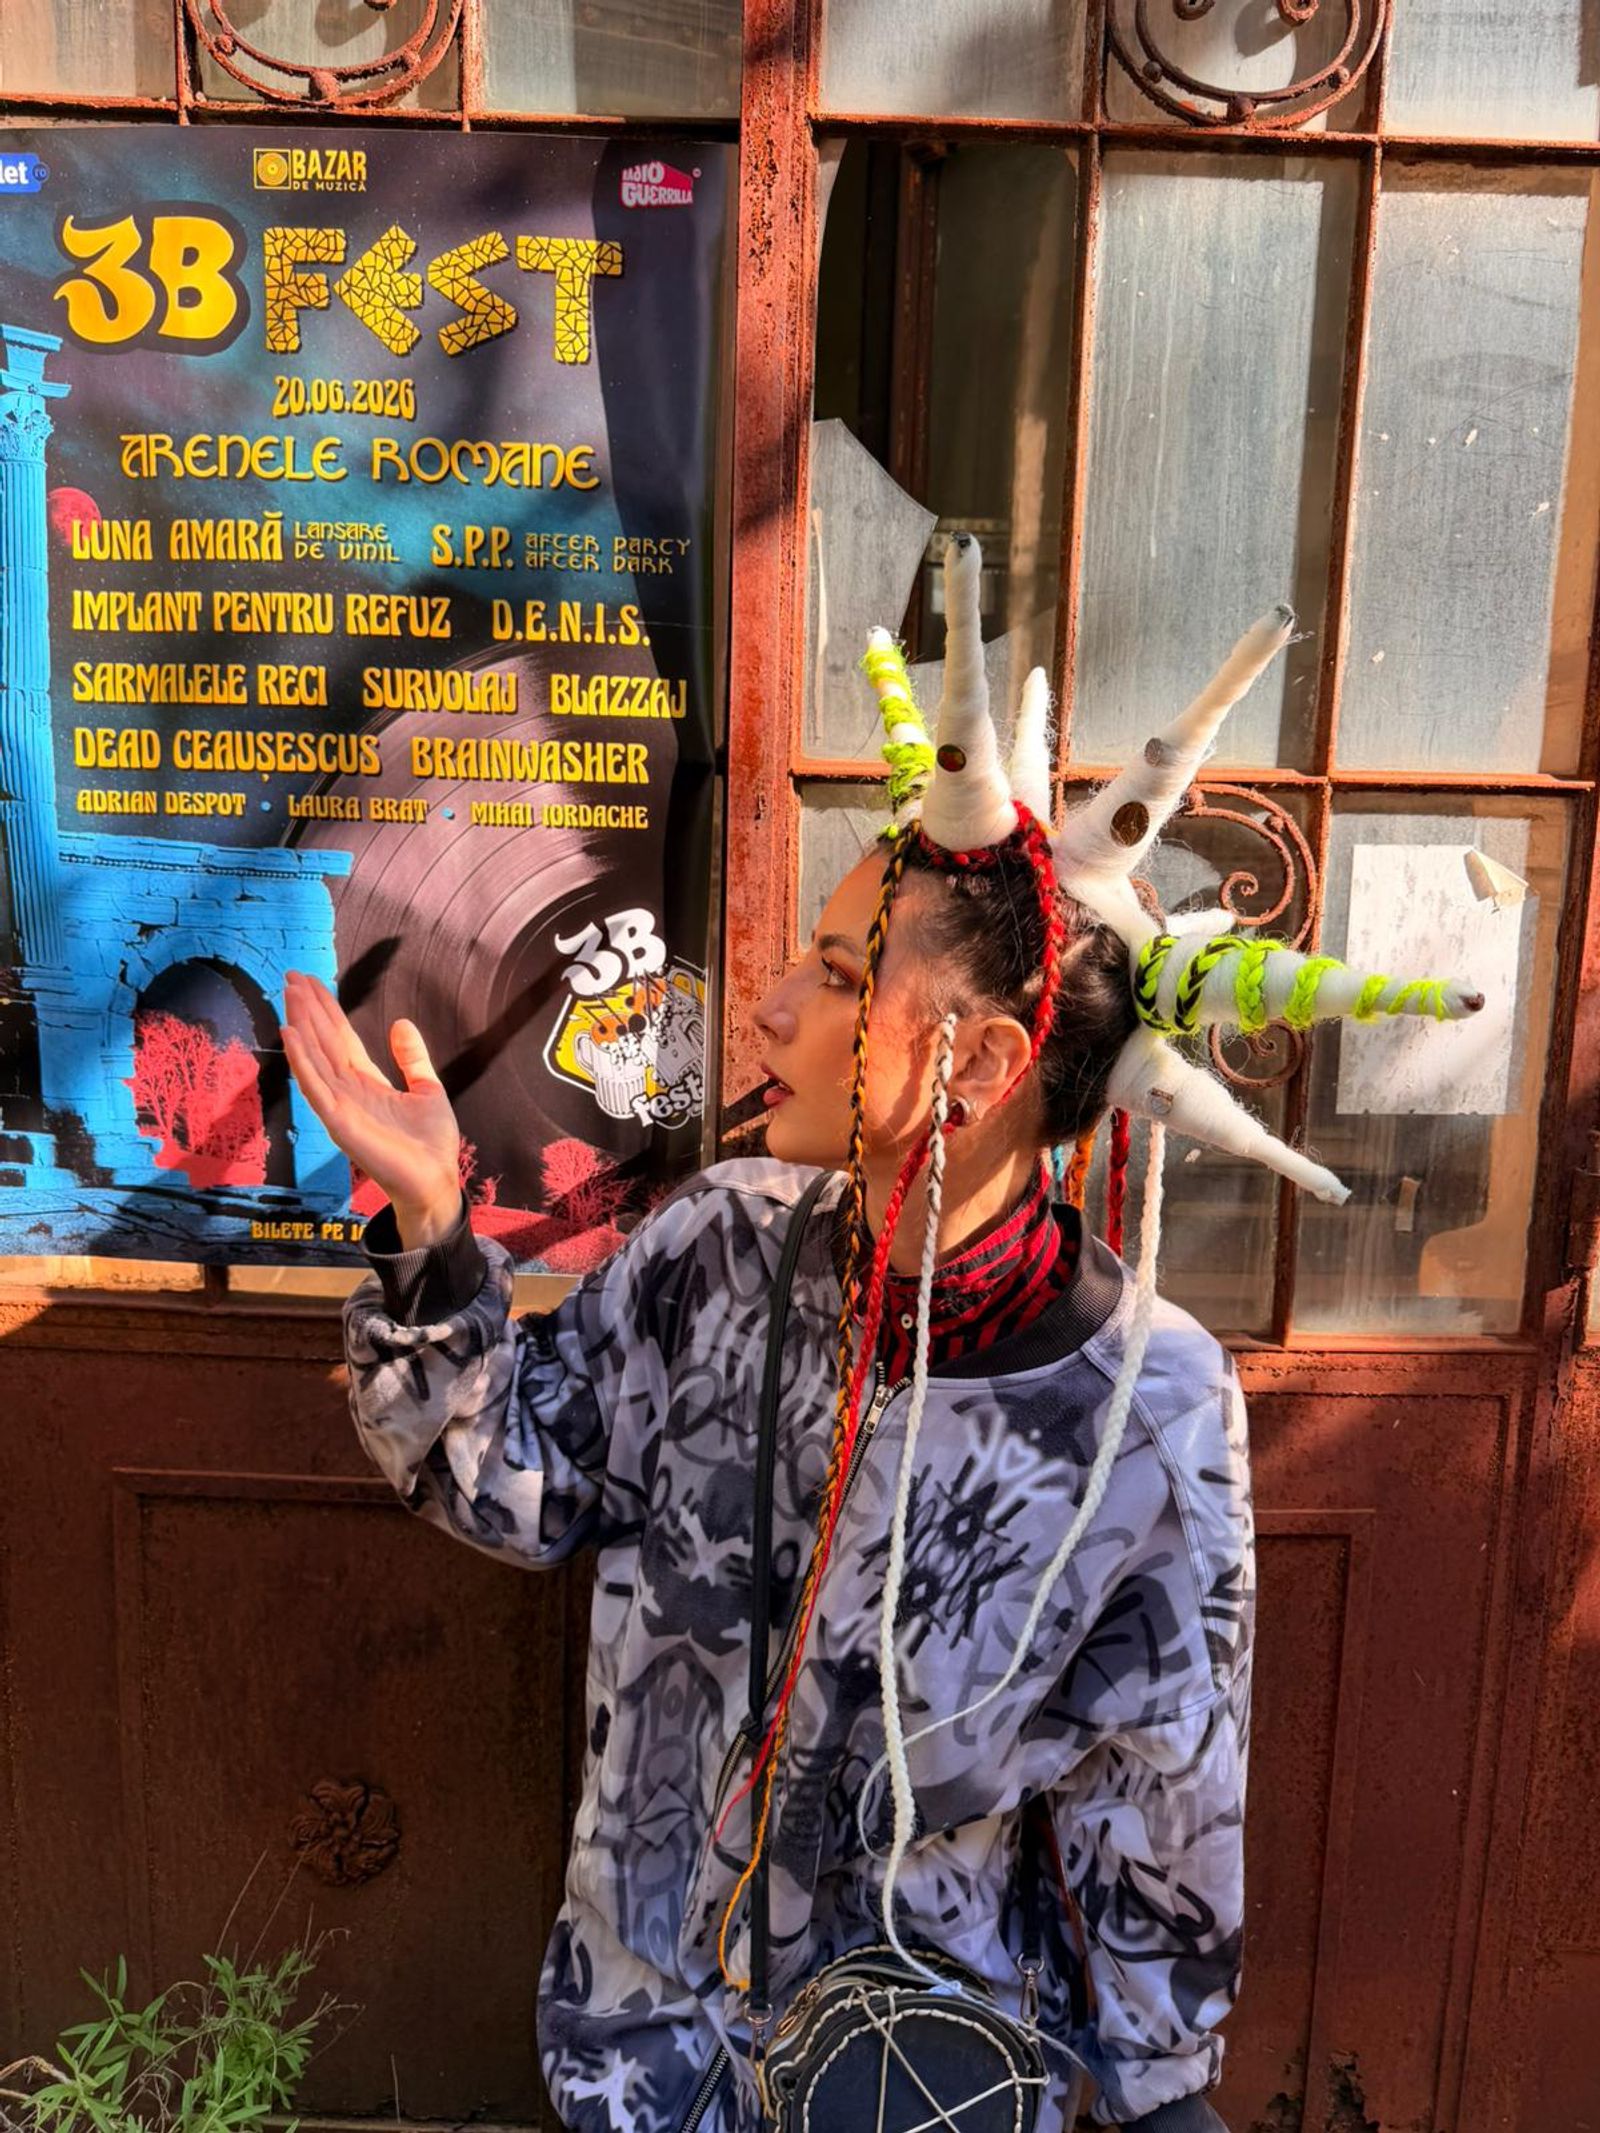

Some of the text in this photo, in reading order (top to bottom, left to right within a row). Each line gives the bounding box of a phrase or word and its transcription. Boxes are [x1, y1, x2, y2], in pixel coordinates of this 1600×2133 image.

[292, 149, 367, 180] BAZAR
[293, 181, 309, 191] DE
[622, 181, 694, 207] GUERRILLA
[54, 214, 623, 364] 3B FEST
[273, 375, 416, 419] 20.06.2026
[120, 433, 600, 490] ARENELE ROMANE
[72, 511, 283, 561] LUNA AMARĂ
[294, 521, 388, 541] LANSARE
[294, 541, 401, 562] DE VINIL
[431, 524, 515, 568] S.P.P.
[613, 554, 674, 574] DARK
[72, 590, 451, 638] IMPLANT PENTRU REFUZ
[492, 599, 651, 646] D.E.N.I.S.
[72, 662, 328, 706] SARMALELE RECI
[363, 667, 517, 713] SURVOLAJ
[550, 673, 687, 718] BLAZZAJ
[74, 727, 161, 769] DEAD
[412, 736, 650, 784] BRAINWASHER
[77, 789, 247, 816] ADRIAN DESPOT
[288, 795, 429, 823] LAURA BRAT
[470, 801, 649, 829] MIHAI IORDACHE
[554, 908, 667, 996] 3B
[252, 1221, 315, 1240] BILETE
[321, 1222, 345, 1241] PE
